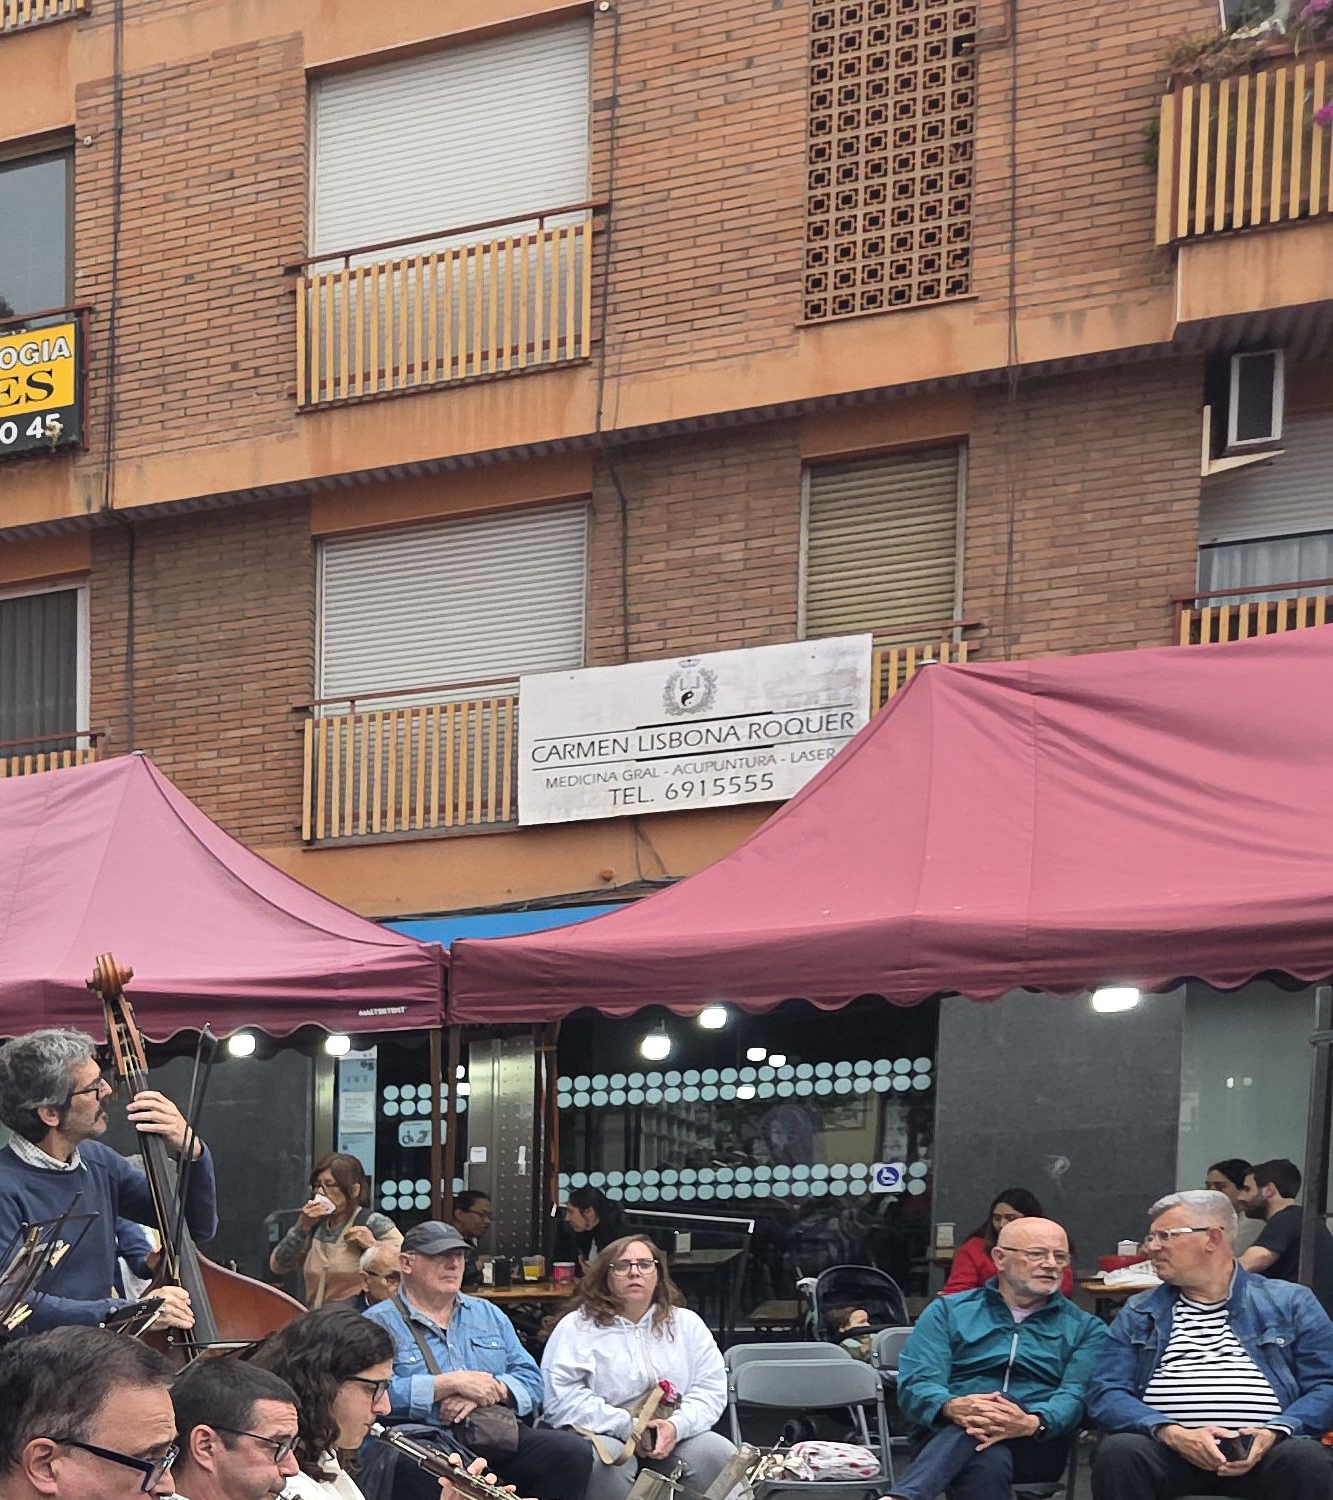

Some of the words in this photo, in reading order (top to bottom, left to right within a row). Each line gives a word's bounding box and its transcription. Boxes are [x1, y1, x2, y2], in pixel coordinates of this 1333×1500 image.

[25, 412, 62, 439] 45
[531, 735, 629, 764] CARMEN
[638, 725, 741, 753] LISBONA
[748, 711, 855, 741] ROQUER
[545, 771, 618, 790] MEDICINA
[622, 767, 661, 782] GRAL
[672, 754, 777, 777] ACUPUNTURA
[790, 747, 836, 764] LASER
[607, 785, 655, 806] TEL.
[664, 772, 774, 801] 6915555
